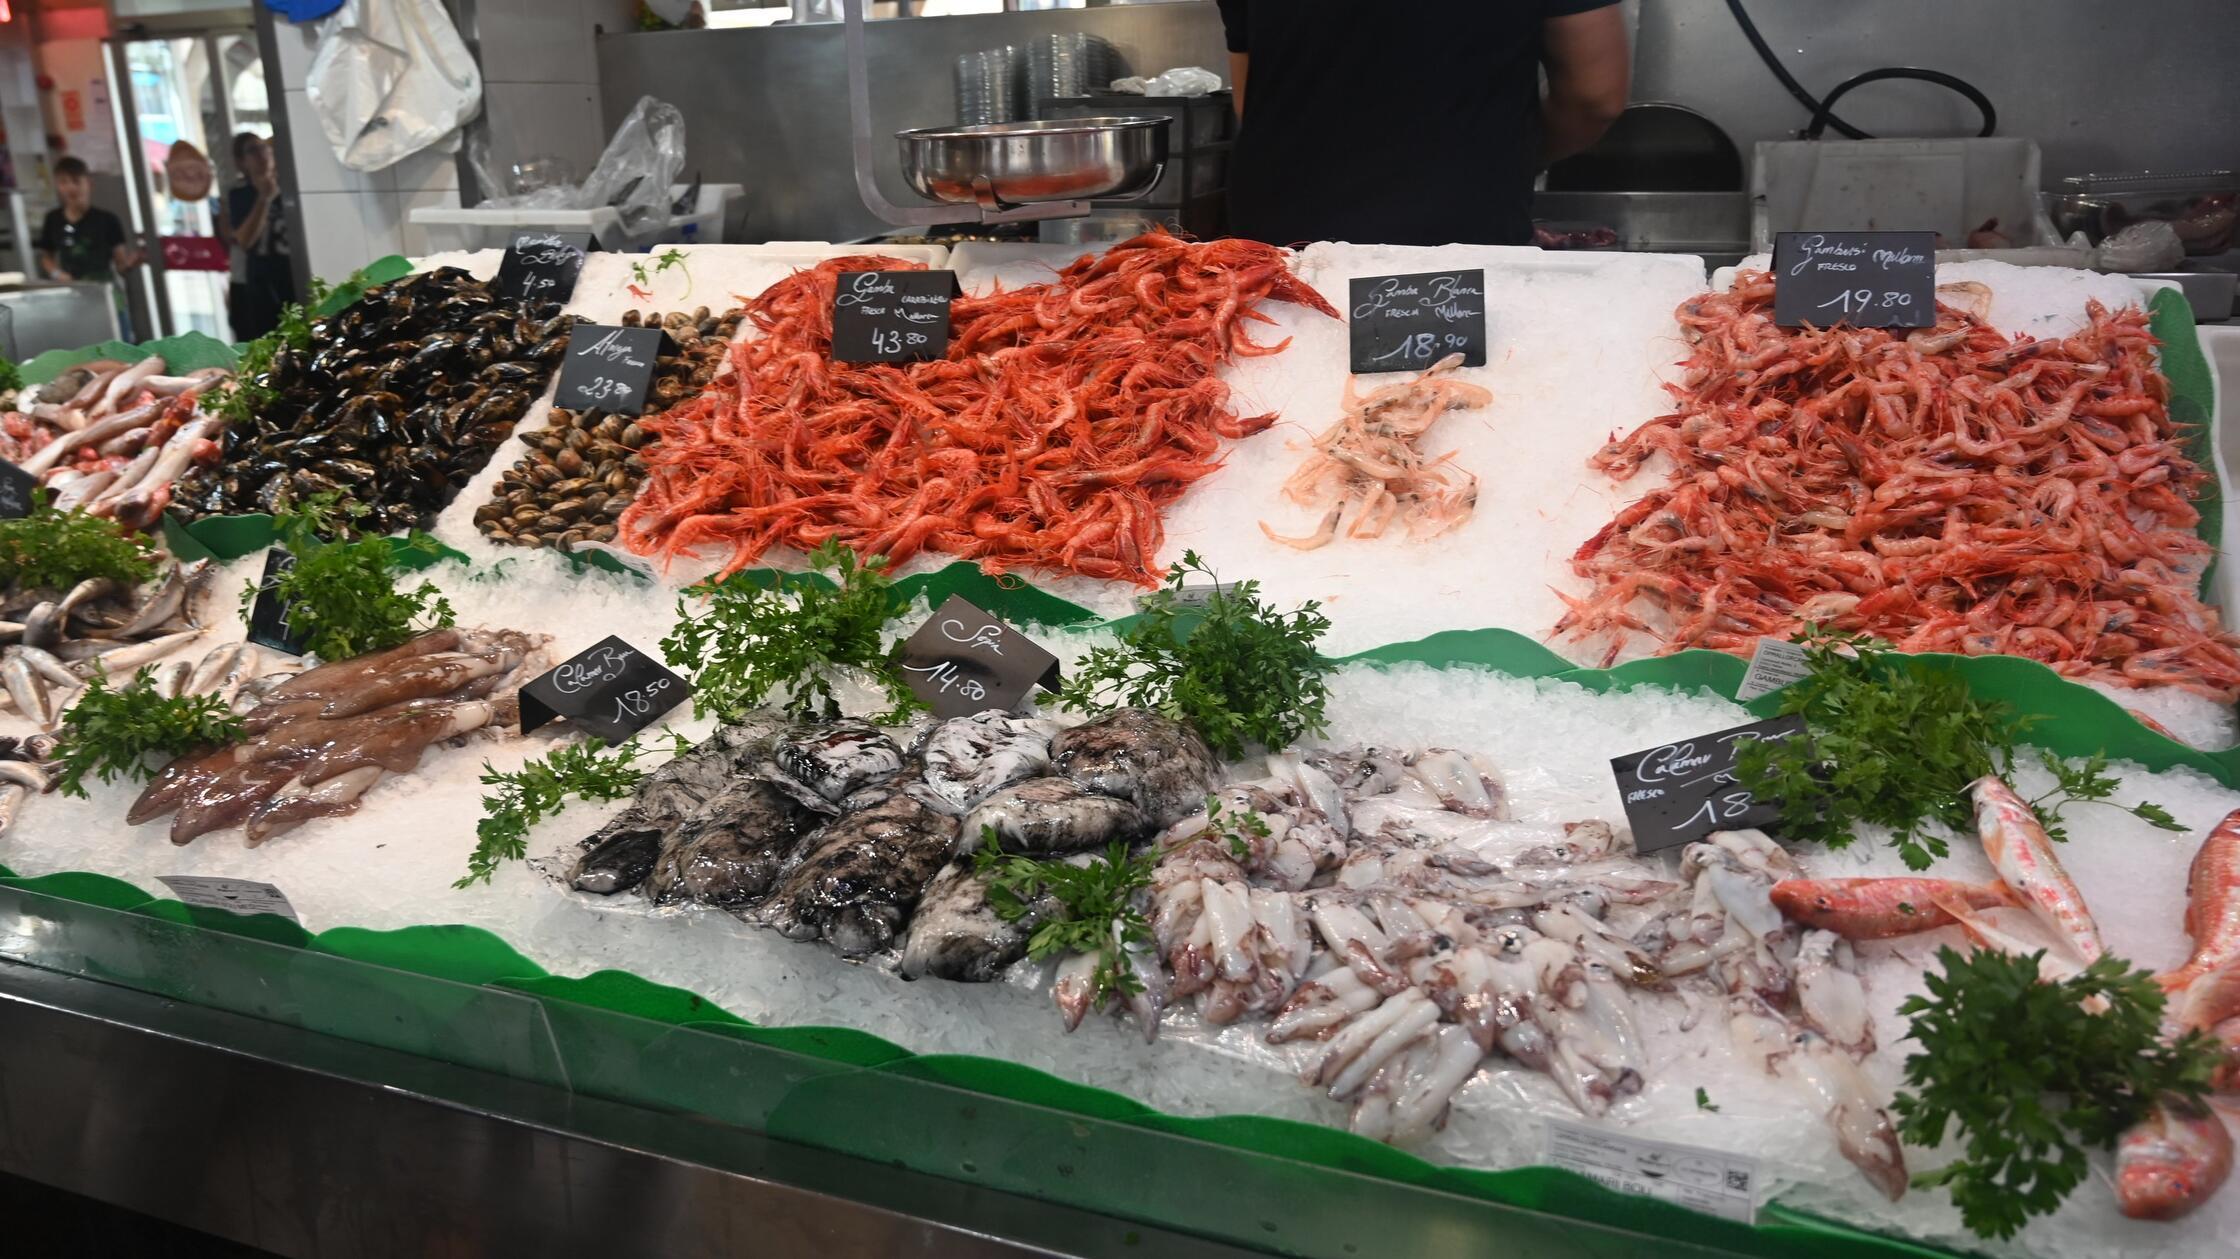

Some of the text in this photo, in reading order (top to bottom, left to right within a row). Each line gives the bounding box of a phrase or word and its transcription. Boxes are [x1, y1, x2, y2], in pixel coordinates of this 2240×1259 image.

[1817, 289, 1912, 313] 19.80
[872, 327, 928, 354] 43.80
[1372, 333, 1468, 361] 18.90
[902, 661, 986, 701] 14.80
[612, 678, 671, 724] 18.50
